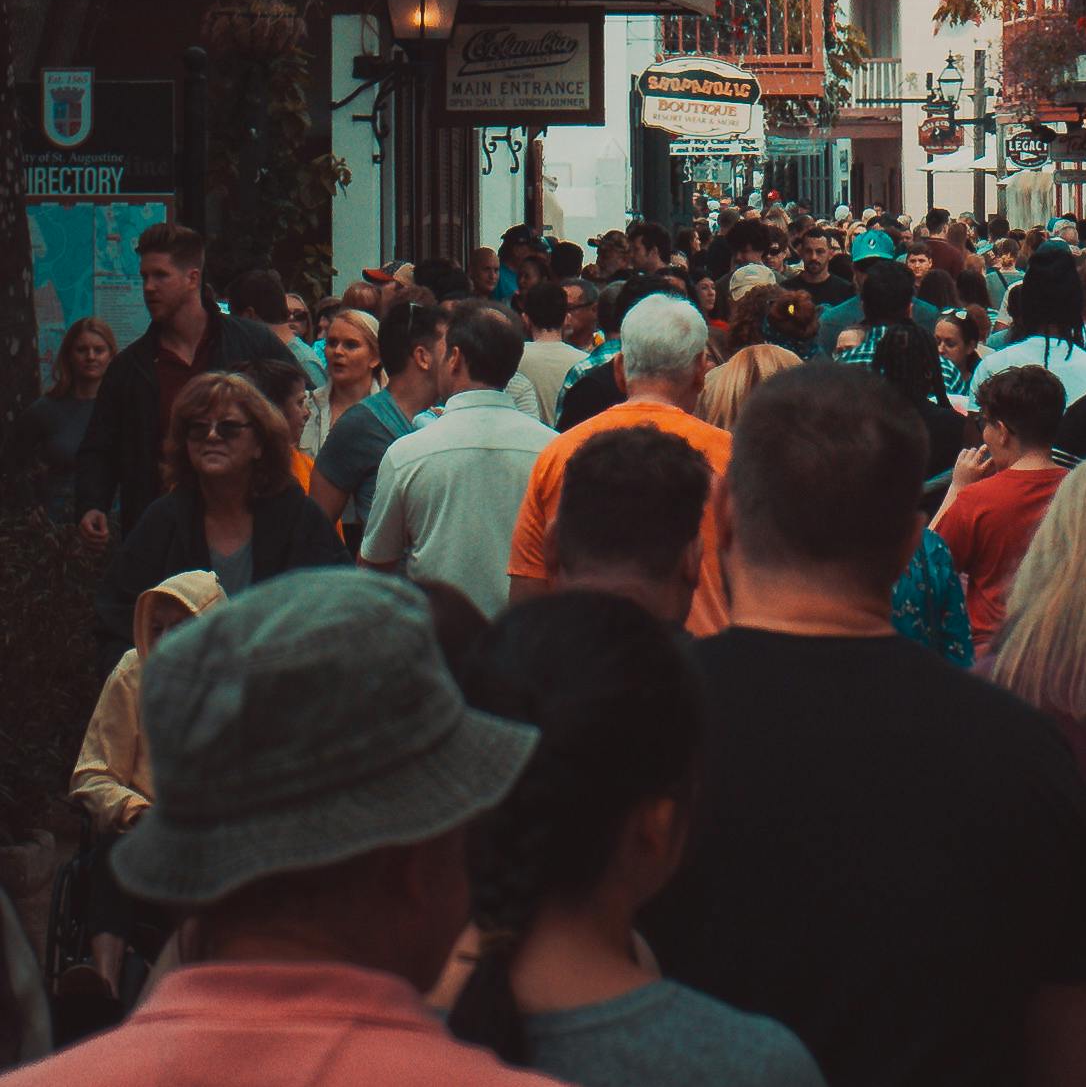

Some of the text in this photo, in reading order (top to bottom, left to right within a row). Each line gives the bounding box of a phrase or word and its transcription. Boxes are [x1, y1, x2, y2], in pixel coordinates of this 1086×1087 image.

[462, 26, 579, 63] Columbia
[452, 81, 585, 95] MAIN ENTRANCE
[647, 75, 752, 98] SHOPAHOLIC
[449, 97, 473, 107] OPEN
[476, 97, 506, 107] DAILY
[550, 98, 586, 107] DINNER
[657, 99, 737, 117] BOUTIQUE
[652, 113, 683, 122] RESORT
[1008, 139, 1048, 152] LEGACY
[21, 152, 125, 165] ity of St. Augustine
